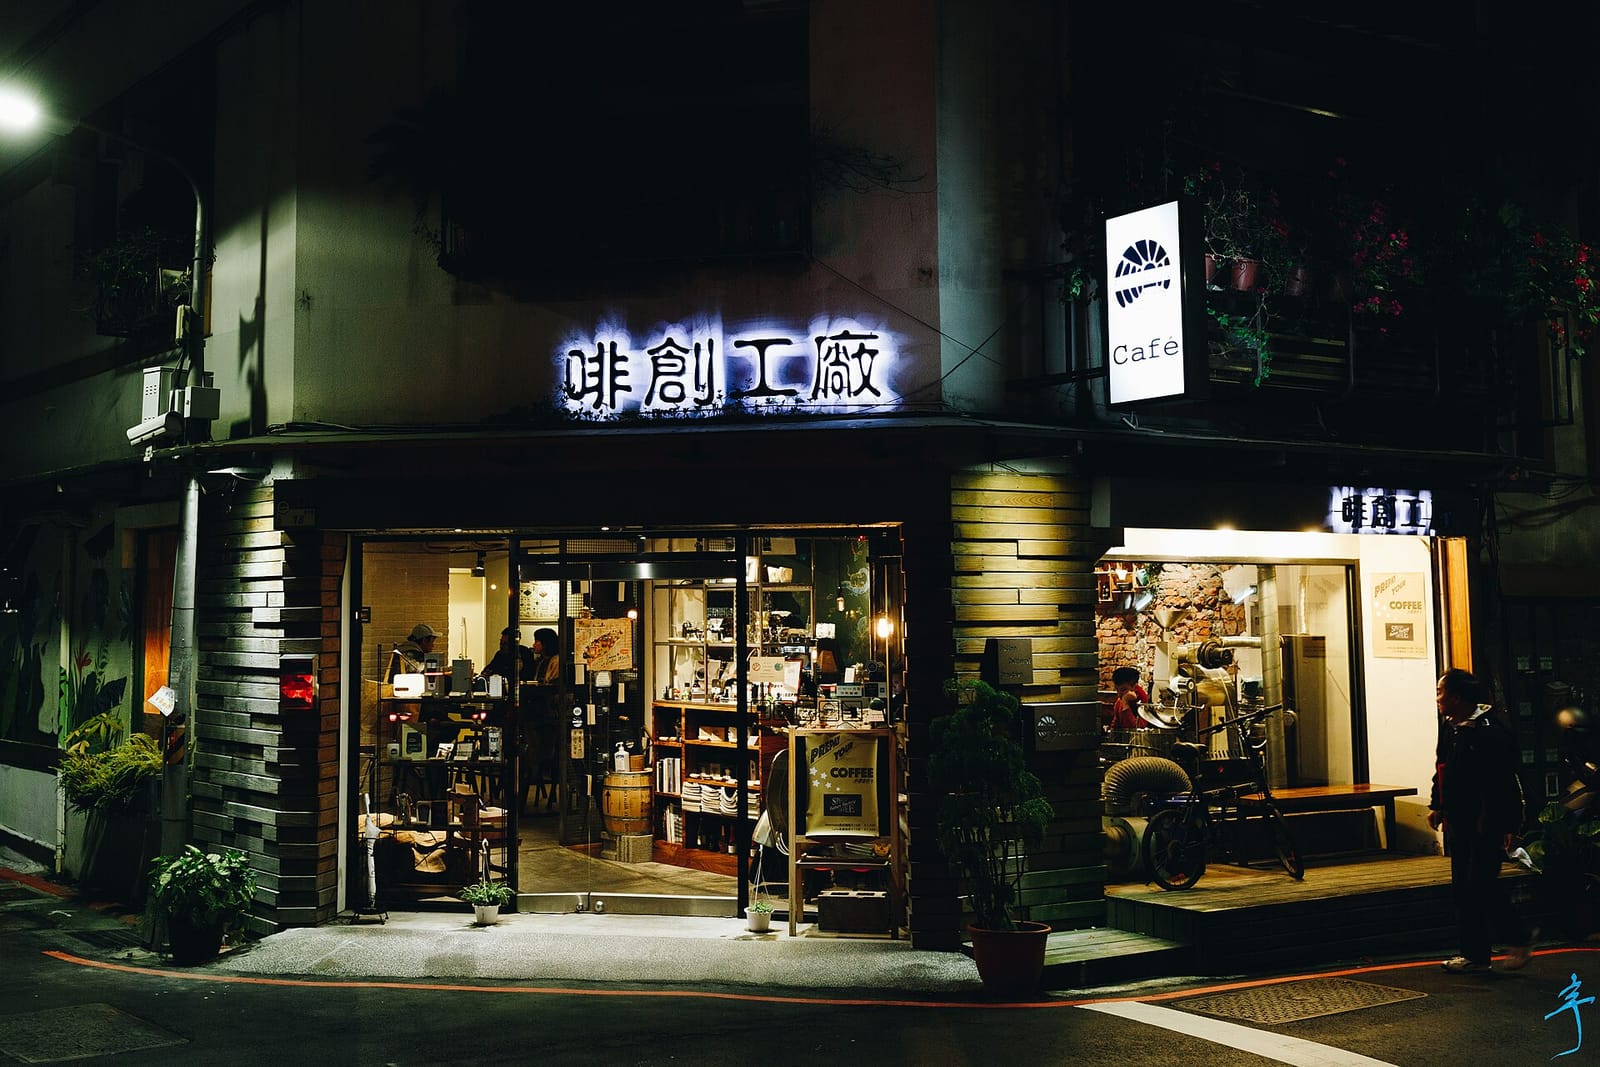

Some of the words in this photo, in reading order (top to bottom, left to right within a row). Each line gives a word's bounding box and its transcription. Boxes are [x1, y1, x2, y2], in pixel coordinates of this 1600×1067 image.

[1113, 336, 1179, 365] Café
[566, 330, 881, 409] 啡創工廠
[1389, 601, 1422, 610] COFFEE
[834, 741, 854, 761] YOUR
[830, 767, 874, 778] COFFEE
